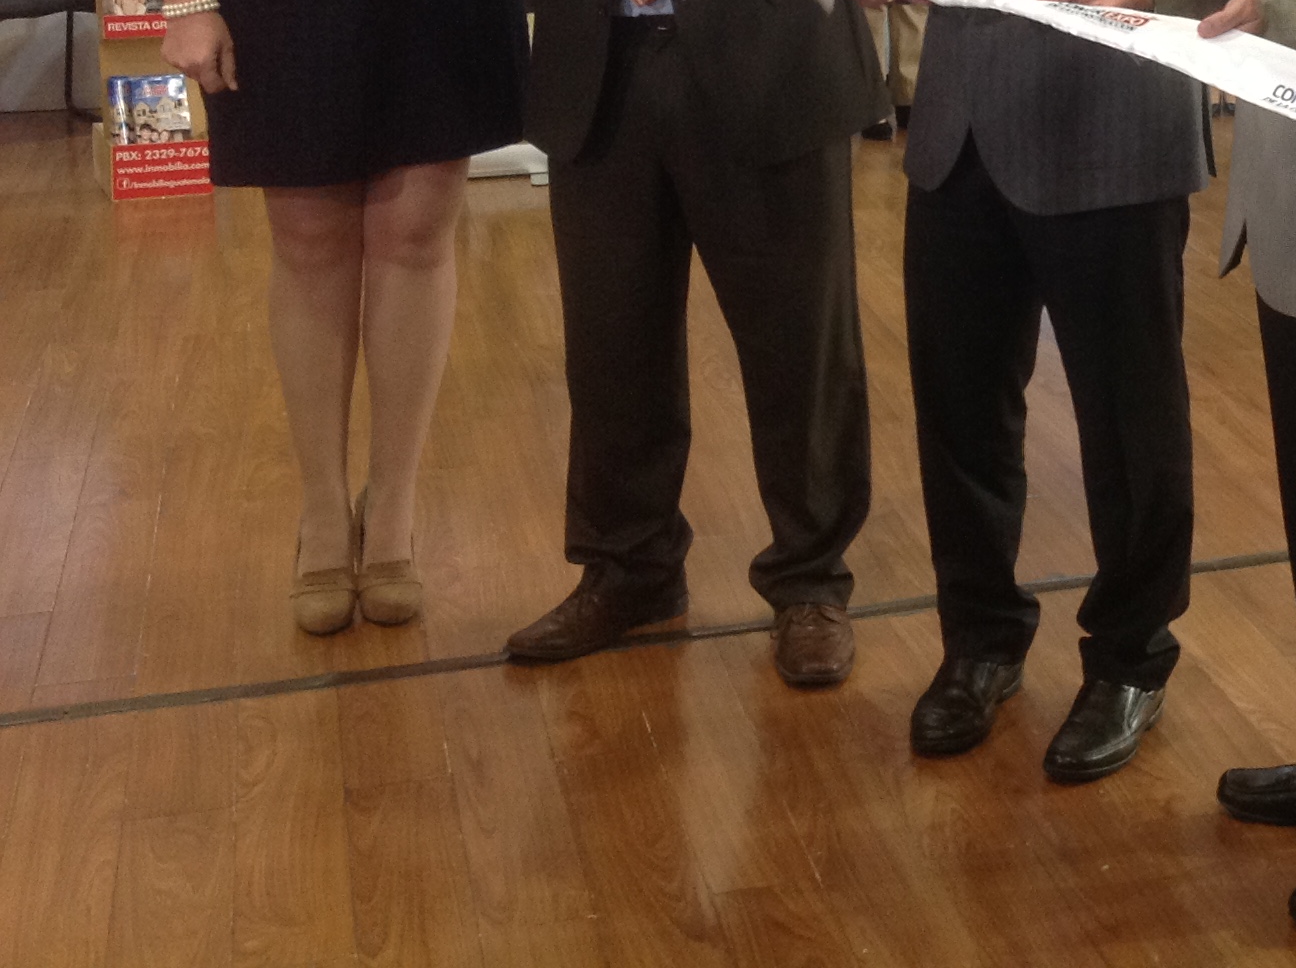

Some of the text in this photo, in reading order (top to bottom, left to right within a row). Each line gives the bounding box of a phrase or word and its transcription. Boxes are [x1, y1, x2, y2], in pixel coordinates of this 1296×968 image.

[107, 21, 150, 32] REVISTA
[115, 146, 210, 162] PBX: 2329-7676
